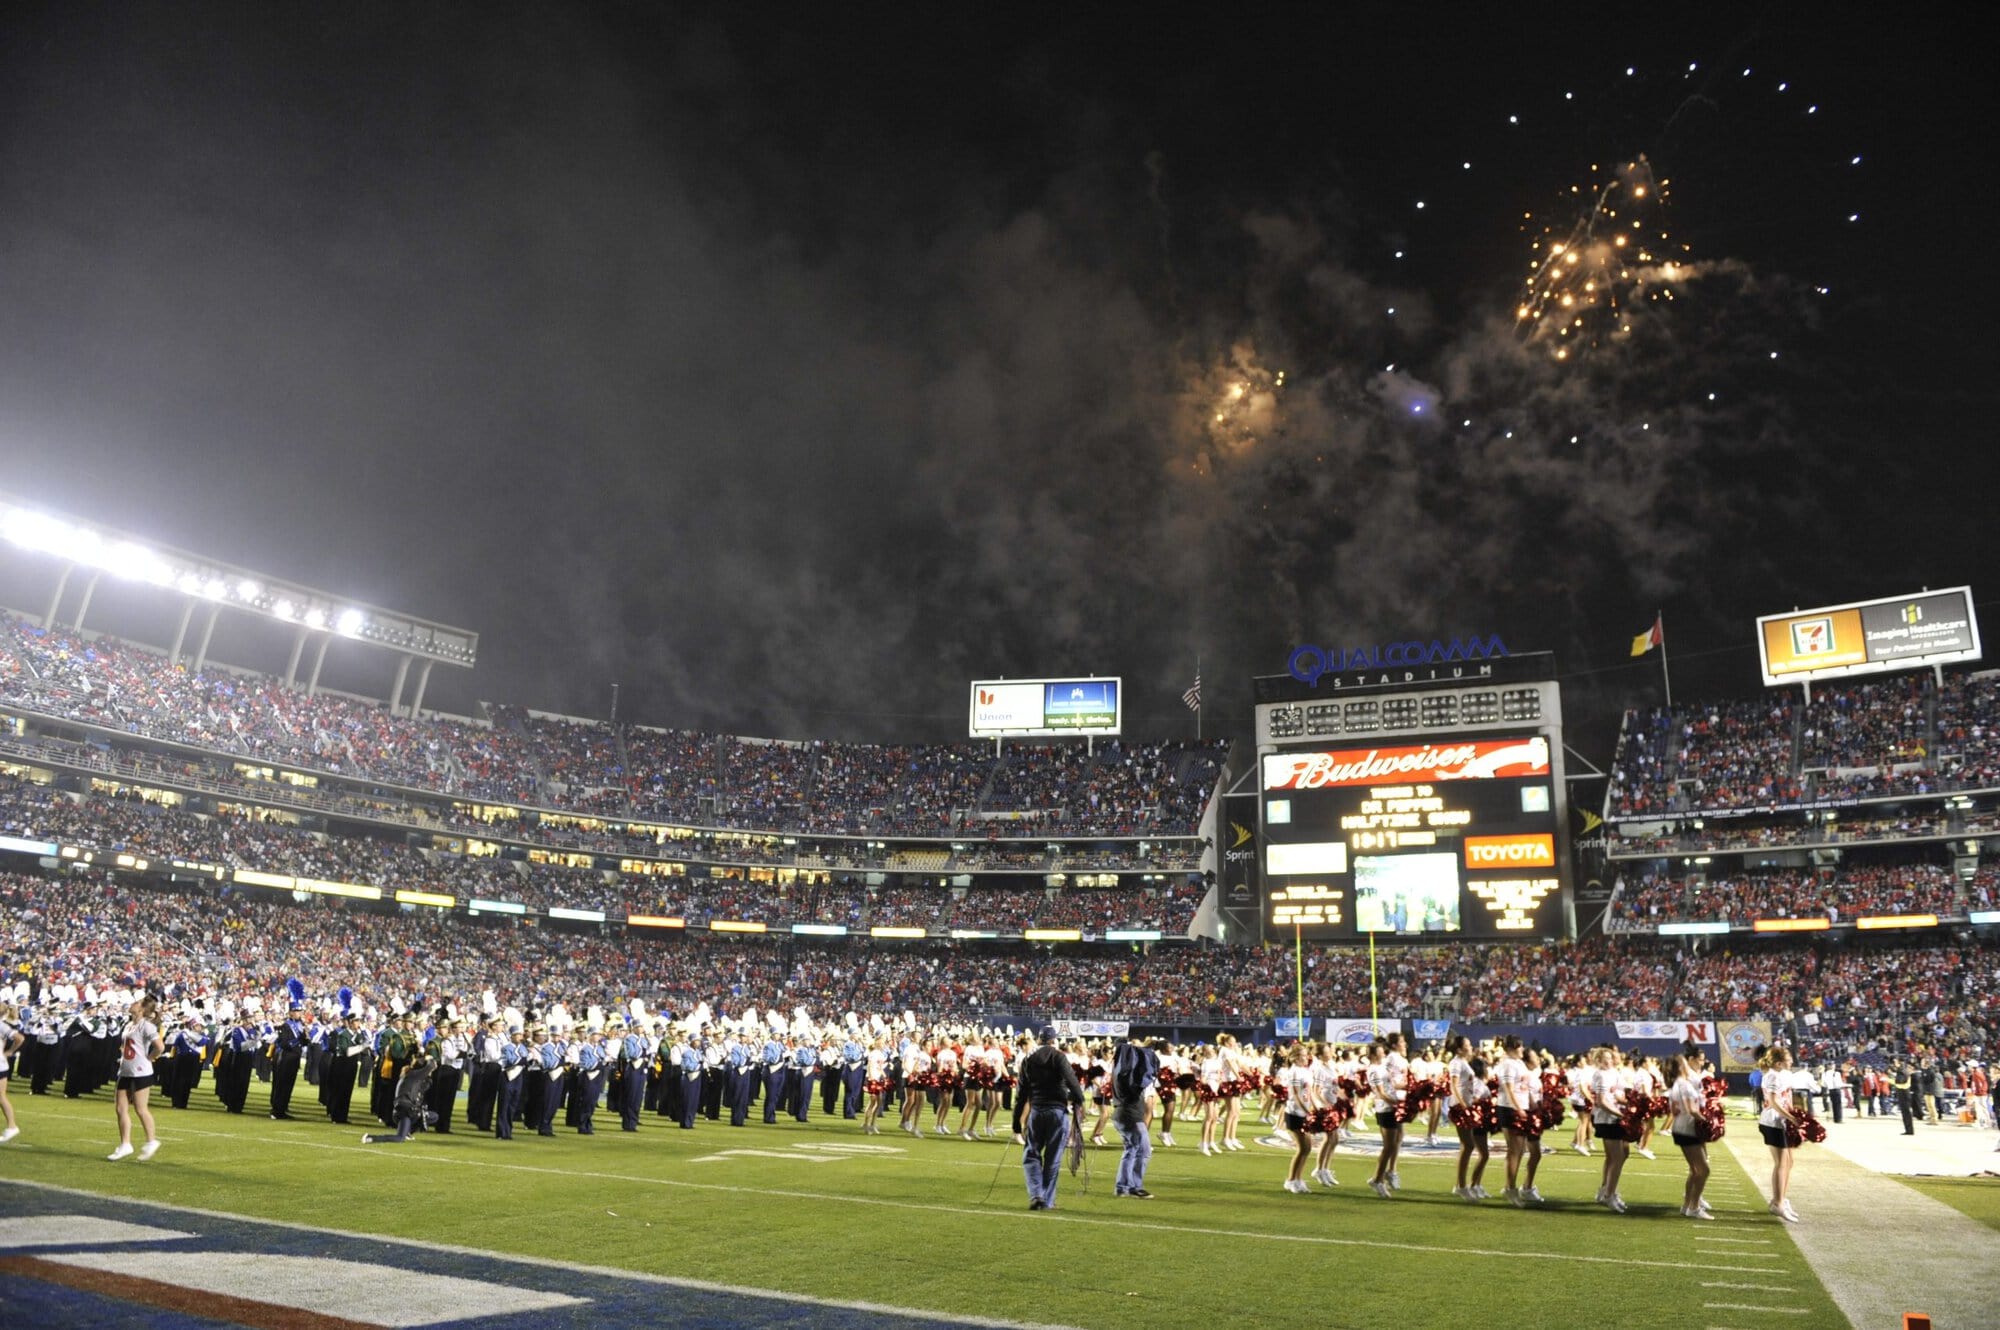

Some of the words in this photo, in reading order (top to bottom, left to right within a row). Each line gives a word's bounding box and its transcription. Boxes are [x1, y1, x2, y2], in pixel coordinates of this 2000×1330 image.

[1866, 628, 1909, 640] Imaging
[1909, 620, 1967, 635] Healthcare
[1288, 634, 1509, 688] QUALCOMM
[1333, 664, 1492, 688] STADIUM
[1290, 745, 1476, 789] Budweiser
[1416, 784, 1434, 797] TO
[1386, 797, 1444, 813] PEPPER
[1341, 812, 1421, 829] HALFTIME
[1225, 849, 1256, 863] Sprint
[1468, 842, 1550, 862] TOYOTA
[1056, 1021, 1073, 1038] A
[1686, 1023, 1708, 1042] N
